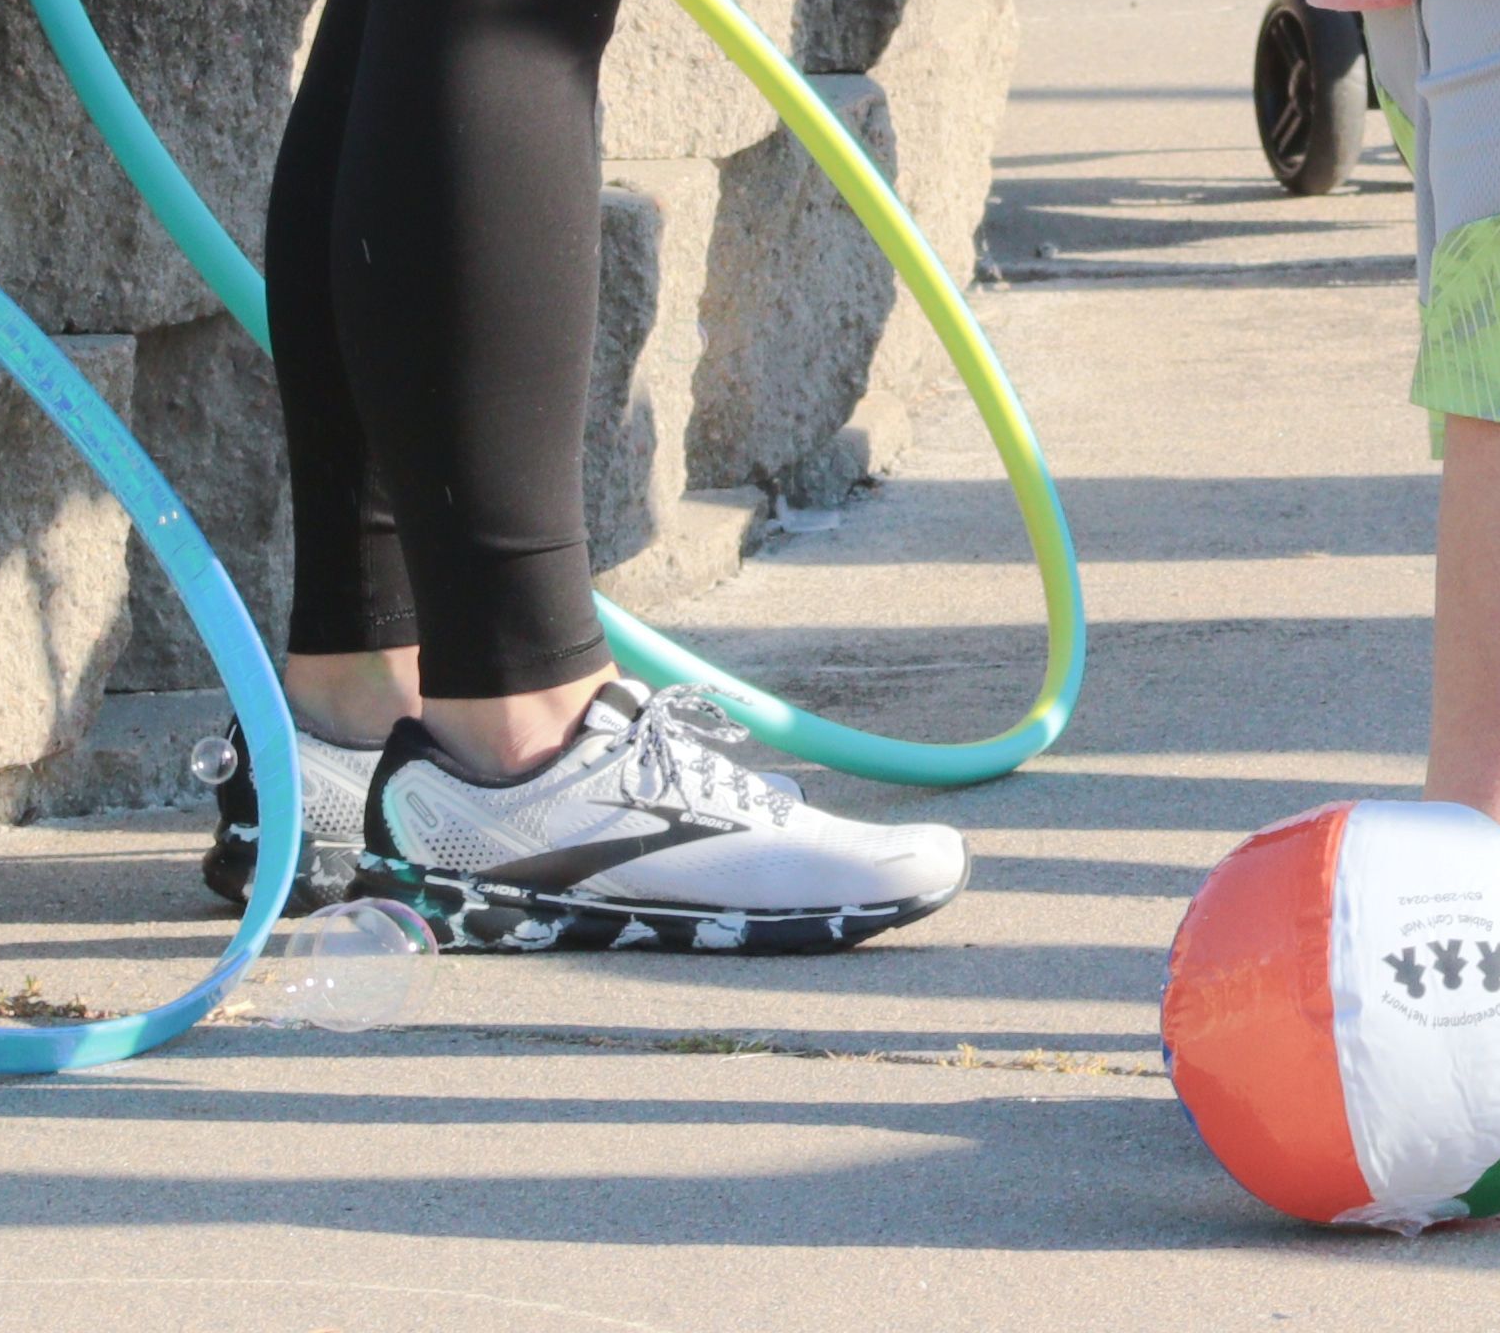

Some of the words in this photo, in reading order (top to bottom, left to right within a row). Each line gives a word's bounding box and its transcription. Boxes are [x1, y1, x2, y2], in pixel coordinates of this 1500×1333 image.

[600, 713, 624, 733] GHO
[476, 882, 532, 900] GHOST
[1399, 919, 1426, 937] Wait
[1427, 913, 1454, 930] Can't
[1457, 913, 1494, 932] Babies
[1380, 989, 1429, 1027] Network
